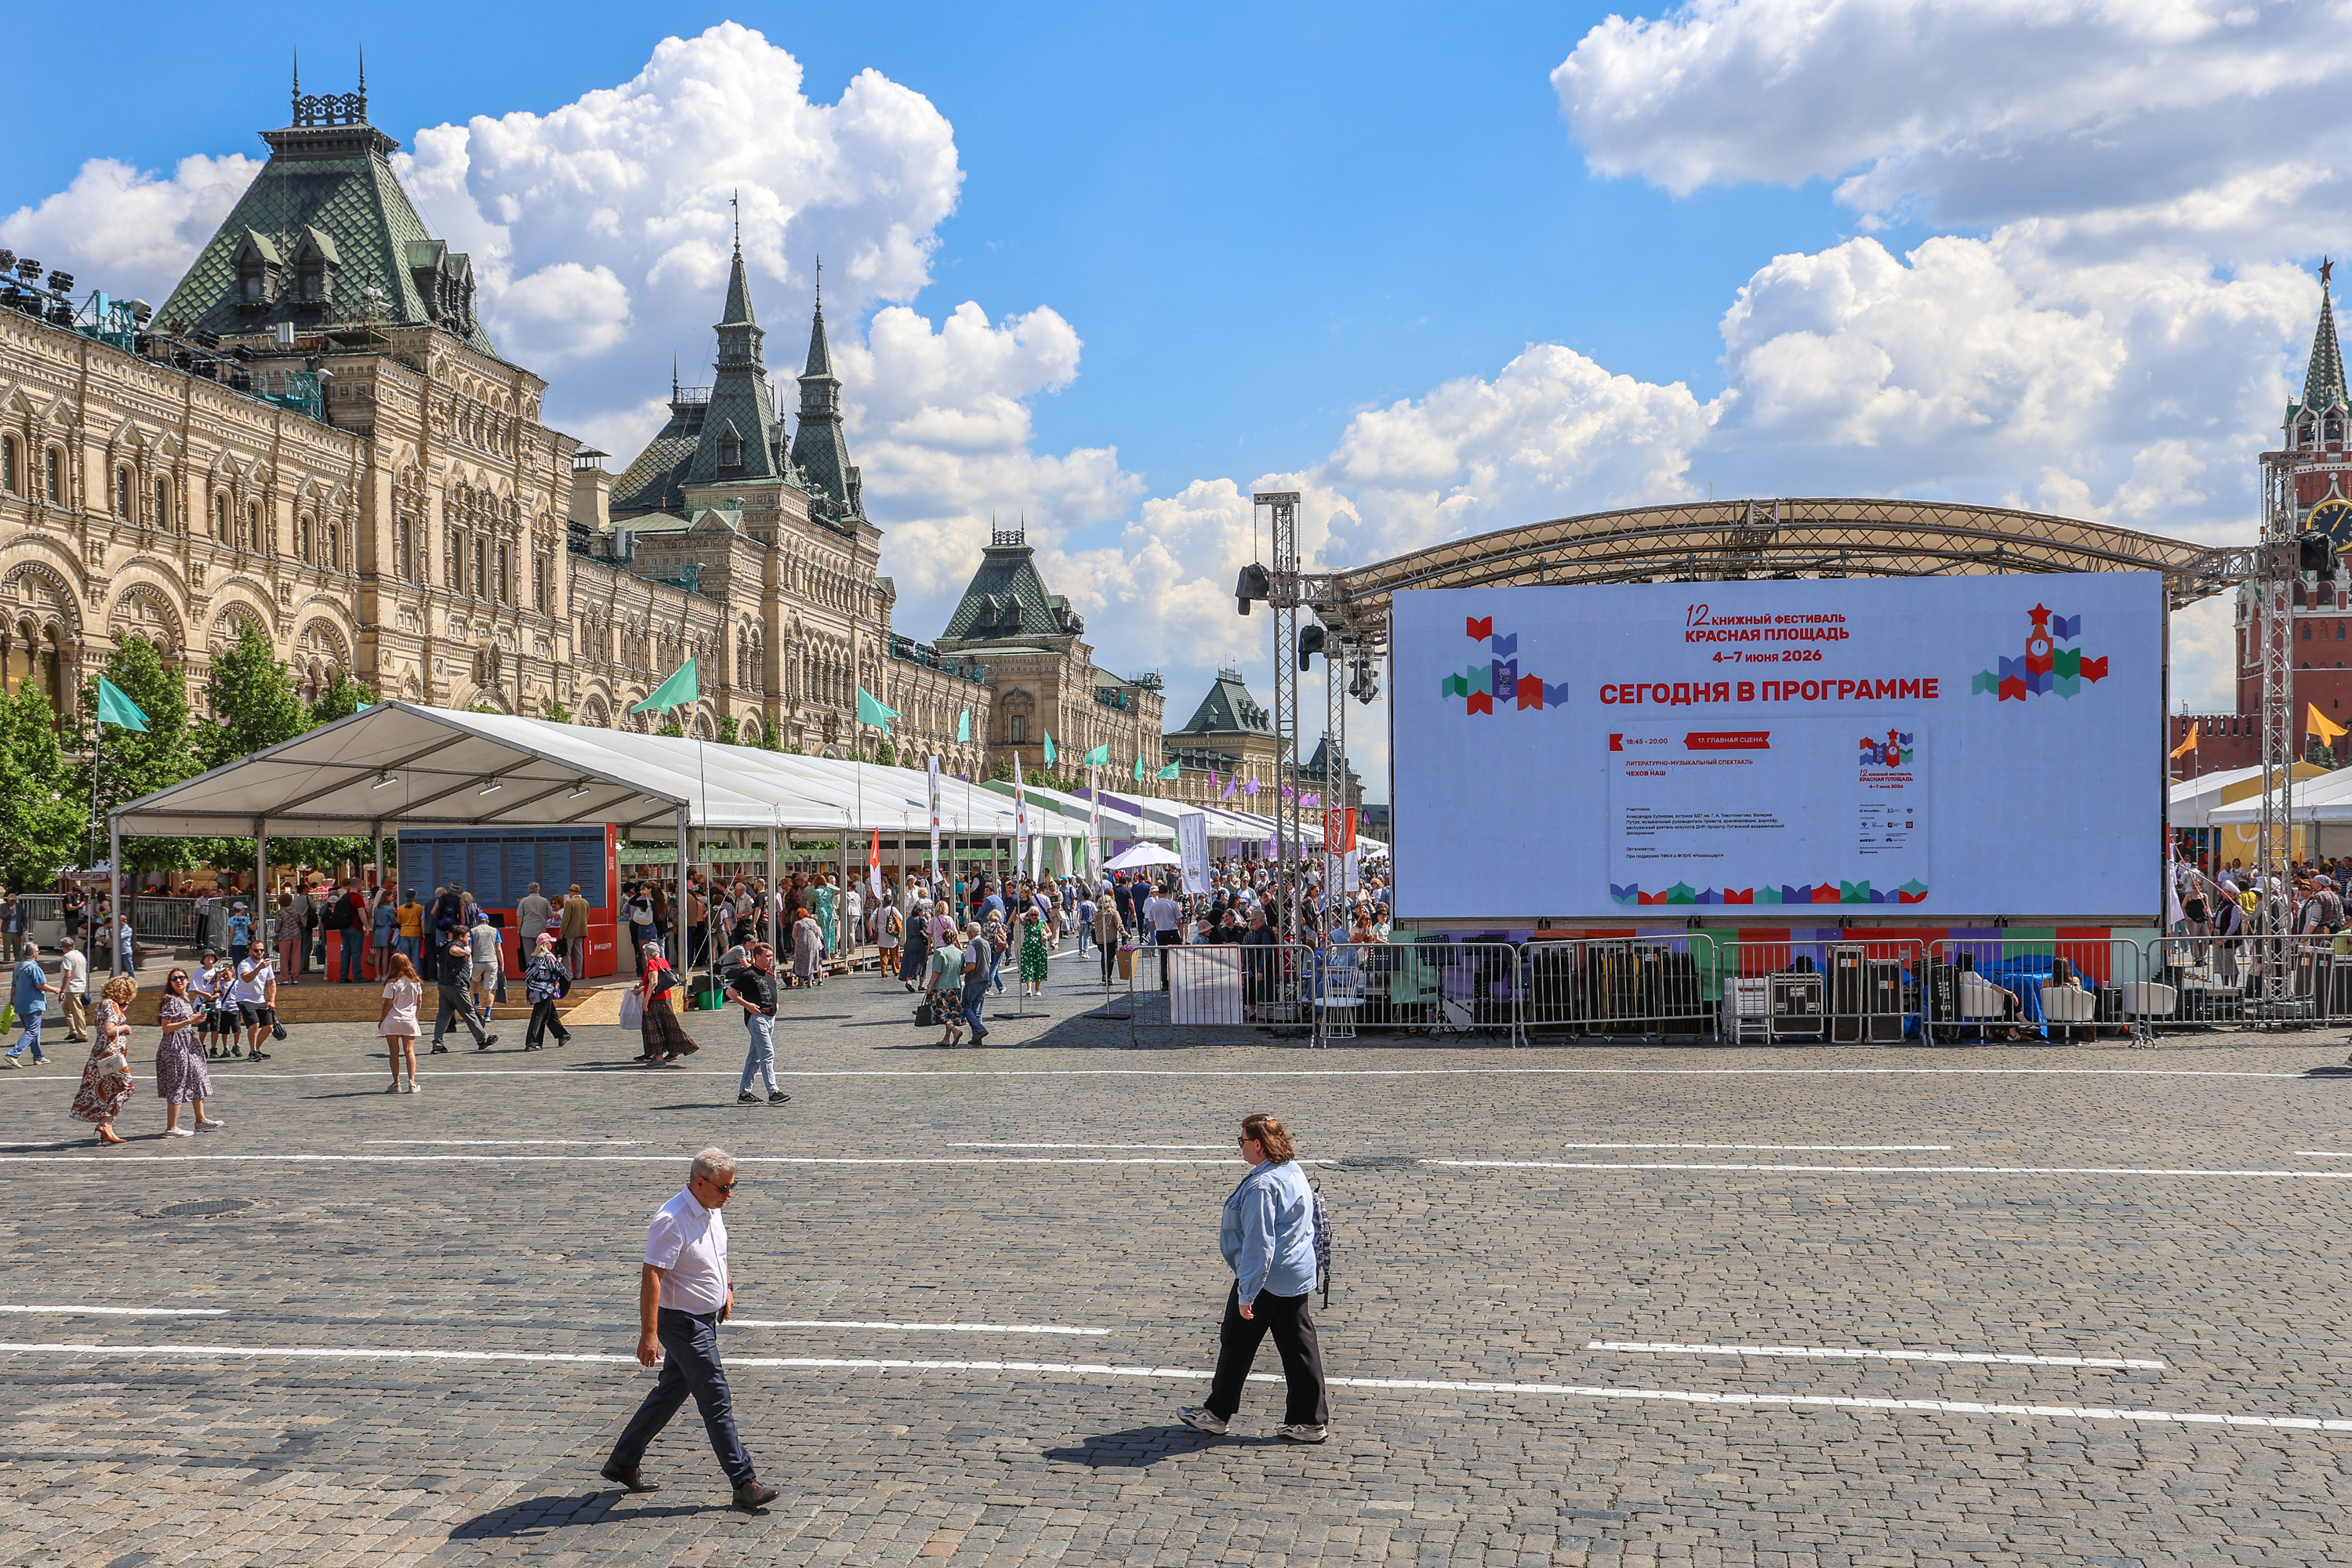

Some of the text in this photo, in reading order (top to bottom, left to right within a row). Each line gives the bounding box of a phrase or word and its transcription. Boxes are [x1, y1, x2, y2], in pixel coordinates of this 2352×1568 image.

[1686, 604, 1846, 626] 12 КНИЖНЫЙ ФЕСТИВАЛЬ
[1685, 627, 1849, 643] КРАСНАЯ ПЛОЩАДЬ
[1745, 653, 1779, 662] июня
[1782, 649, 1823, 662] 2026
[1599, 678, 1940, 706] СЕГОДНЯ В ПРОГРАММЕ
[1860, 768, 1868, 777] 12
